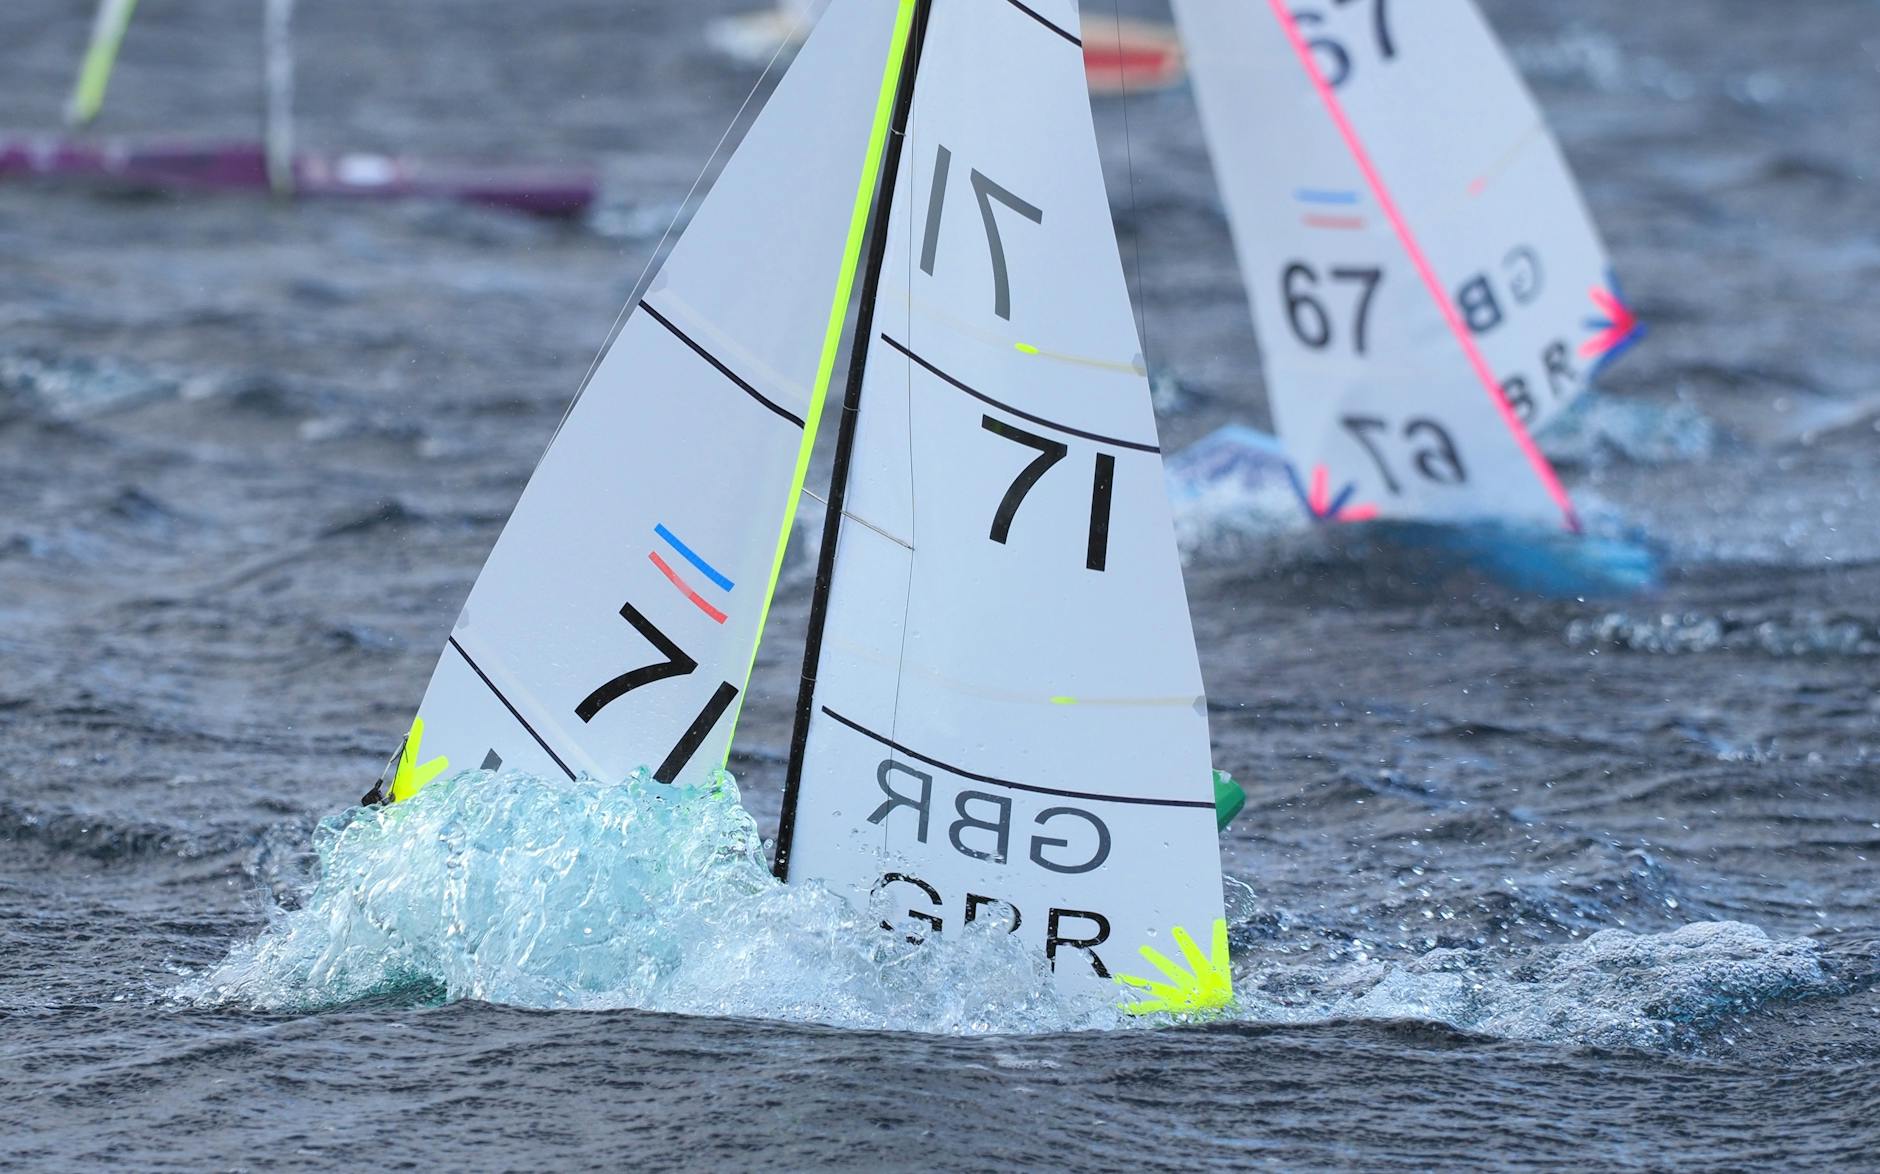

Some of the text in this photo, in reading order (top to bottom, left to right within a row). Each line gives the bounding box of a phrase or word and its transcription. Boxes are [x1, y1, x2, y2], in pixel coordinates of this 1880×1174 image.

[1280, 262, 1384, 354] 67
[1499, 340, 1577, 427] BR
[982, 414, 1115, 571] 71
[574, 601, 739, 784] 71
